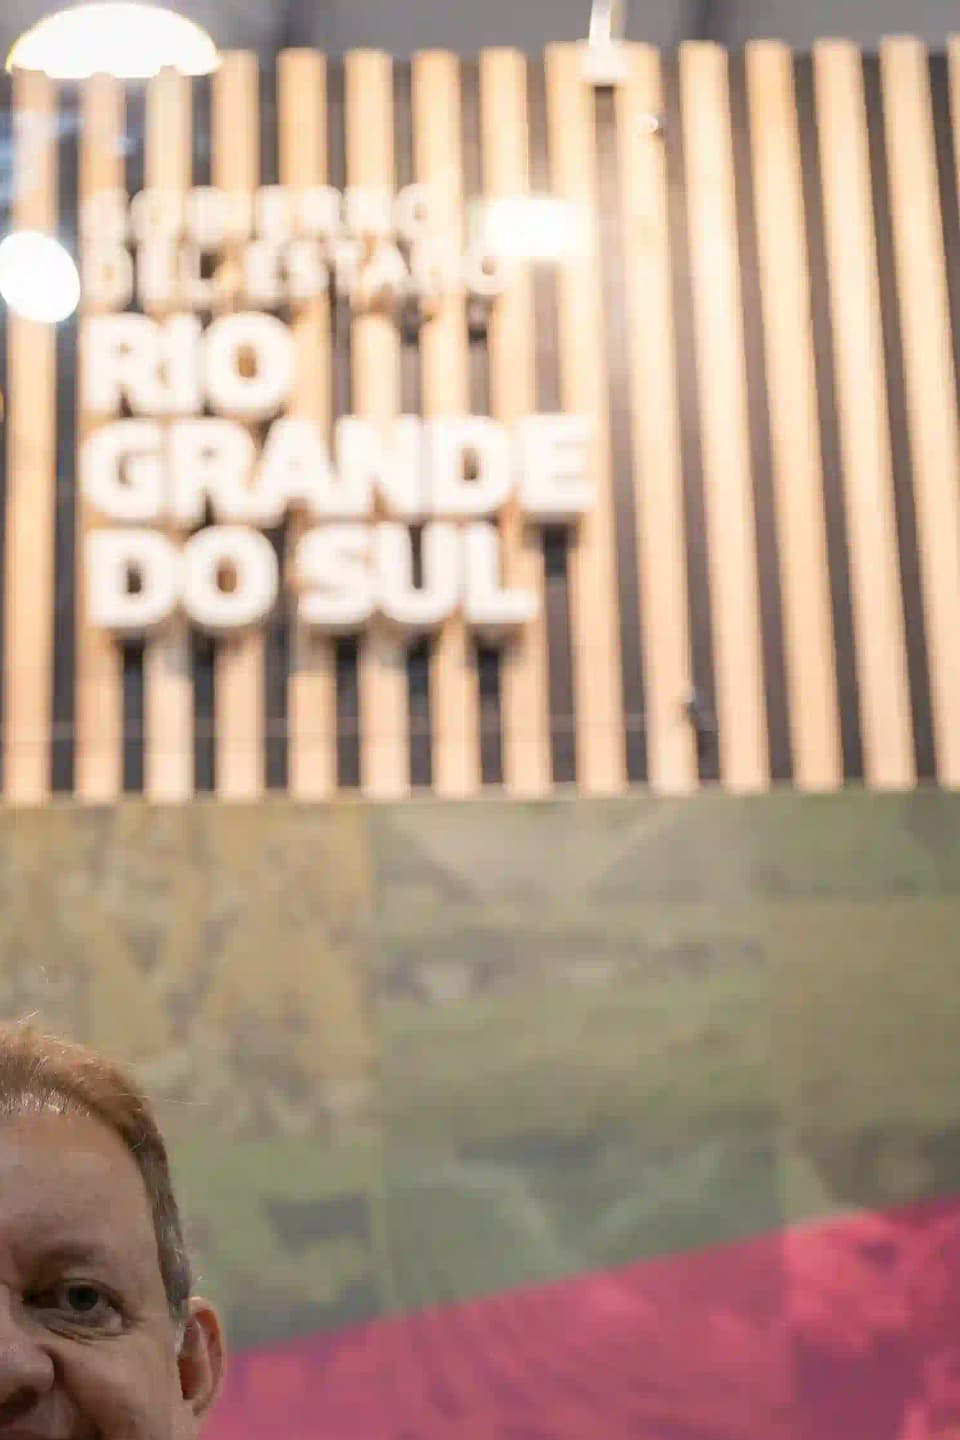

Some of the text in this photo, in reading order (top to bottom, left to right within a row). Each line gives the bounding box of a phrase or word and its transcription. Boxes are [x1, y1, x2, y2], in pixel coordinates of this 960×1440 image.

[82, 312, 292, 416] RIO
[80, 413, 596, 522] GRANDE
[86, 521, 540, 630] DO SUL
